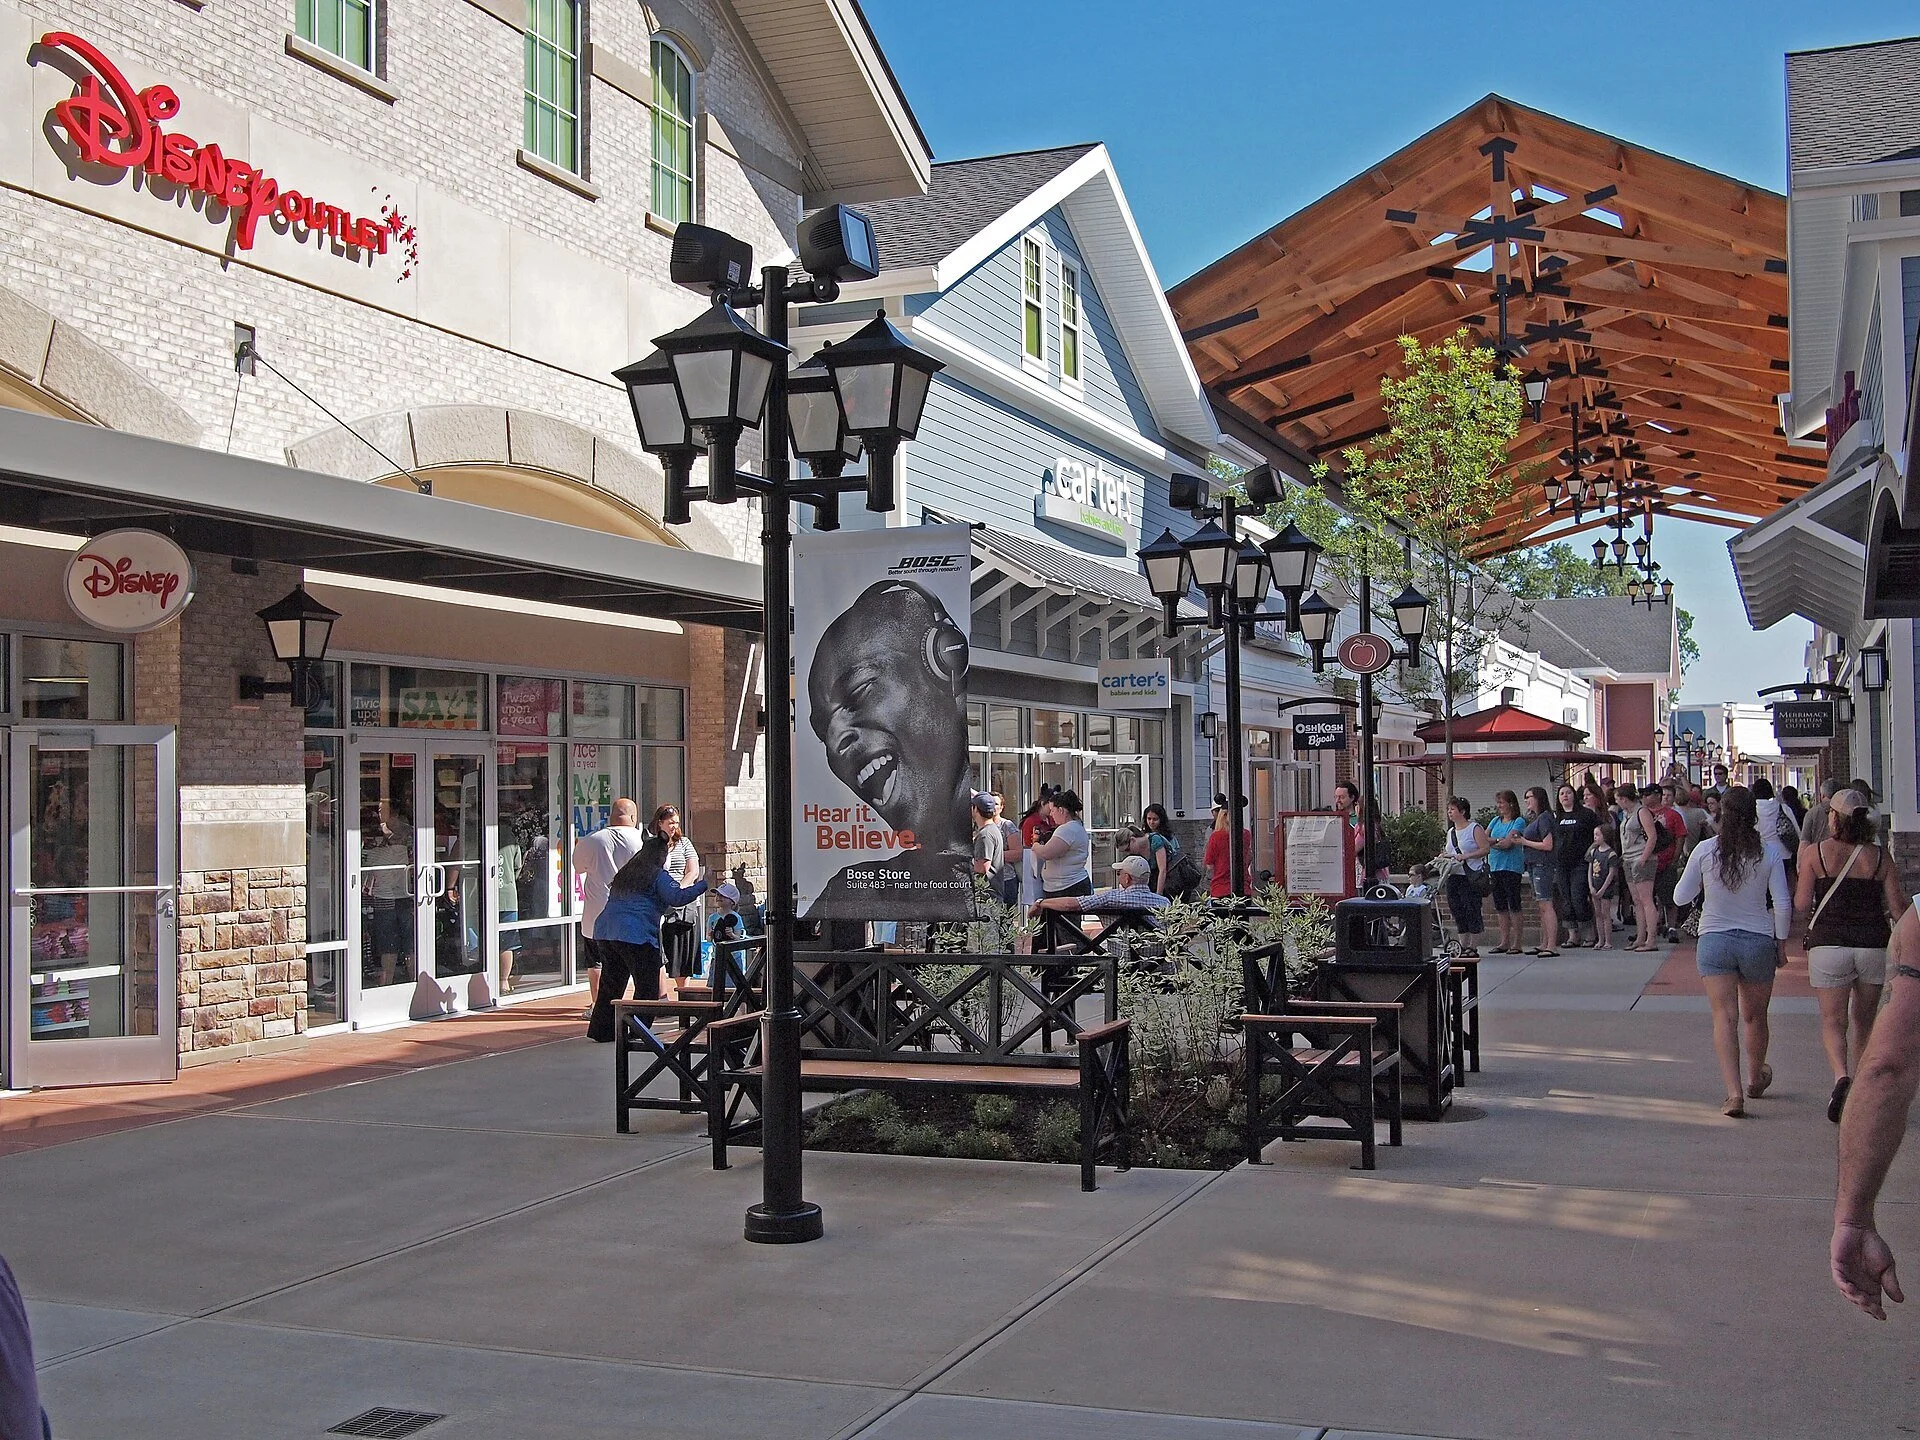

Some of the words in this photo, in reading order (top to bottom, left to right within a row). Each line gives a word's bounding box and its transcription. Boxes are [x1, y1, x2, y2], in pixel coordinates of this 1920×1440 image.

[40, 31, 278, 250] Disney
[280, 189, 392, 255] OUTLET
[888, 554, 965, 569] BOSE
[78, 554, 179, 609] Disney
[1101, 671, 1166, 688] carter's
[353, 696, 380, 709] Twic
[501, 705, 531, 717] upon
[500, 716, 509, 725] a
[511, 715, 538, 728] year
[803, 804, 851, 823] Hear
[856, 804, 877, 823] it.
[816, 825, 922, 850] Believe.
[846, 869, 875, 880] Bose
[878, 869, 911, 880] Store
[846, 880, 868, 889] Suite
[868, 881, 886, 889] 483
[914, 880, 928, 889] the
[929, 880, 948, 889] food
[949, 881, 972, 889] court
